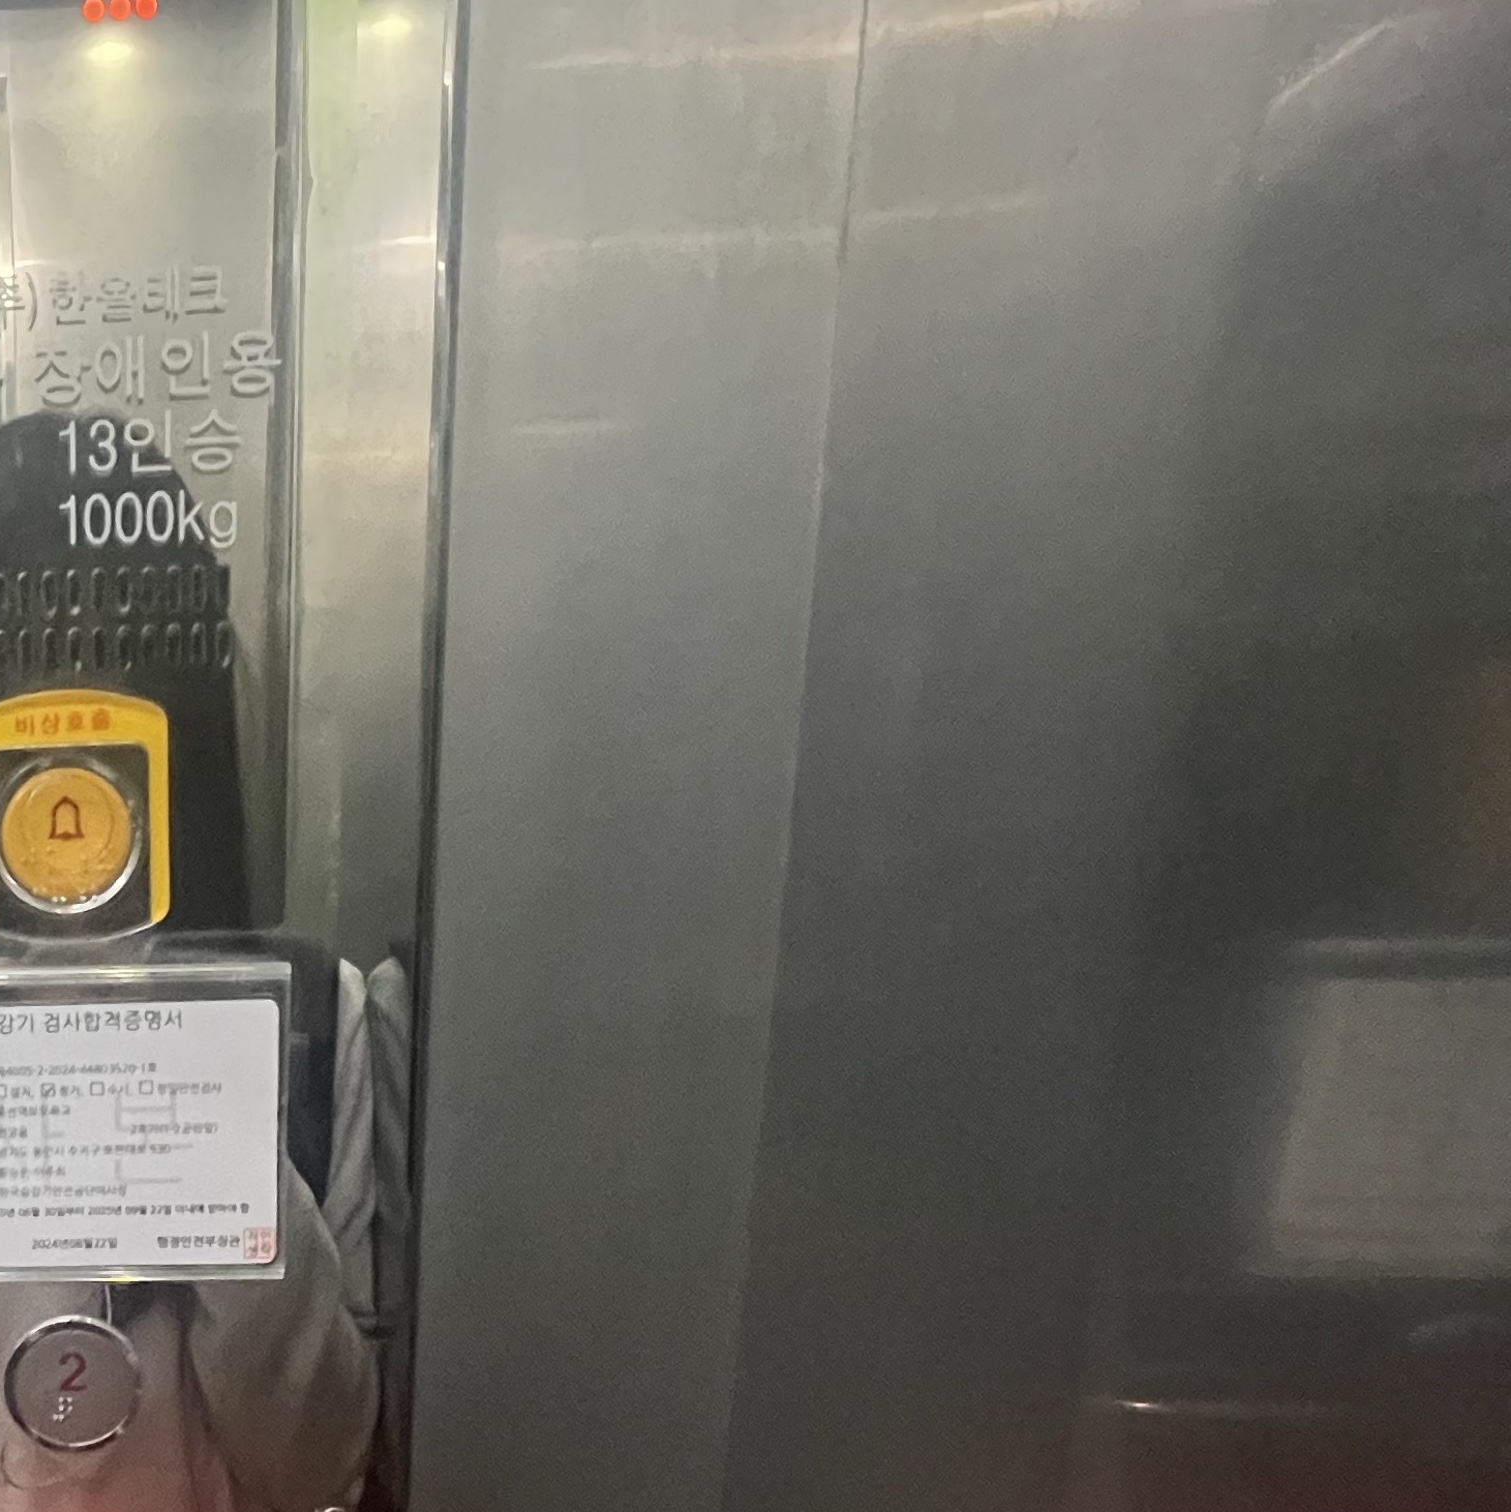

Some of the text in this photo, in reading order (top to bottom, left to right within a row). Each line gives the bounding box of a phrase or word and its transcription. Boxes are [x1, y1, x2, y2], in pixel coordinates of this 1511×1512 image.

[34, 330, 282, 407] 장애인용
[59, 408, 242, 474] 13인승
[59, 489, 238, 549] 1000kg
[15, 708, 112, 736] 비상호출
[44, 1010, 183, 1034] 검사합격증명서
[59, 1352, 87, 1392] 2
